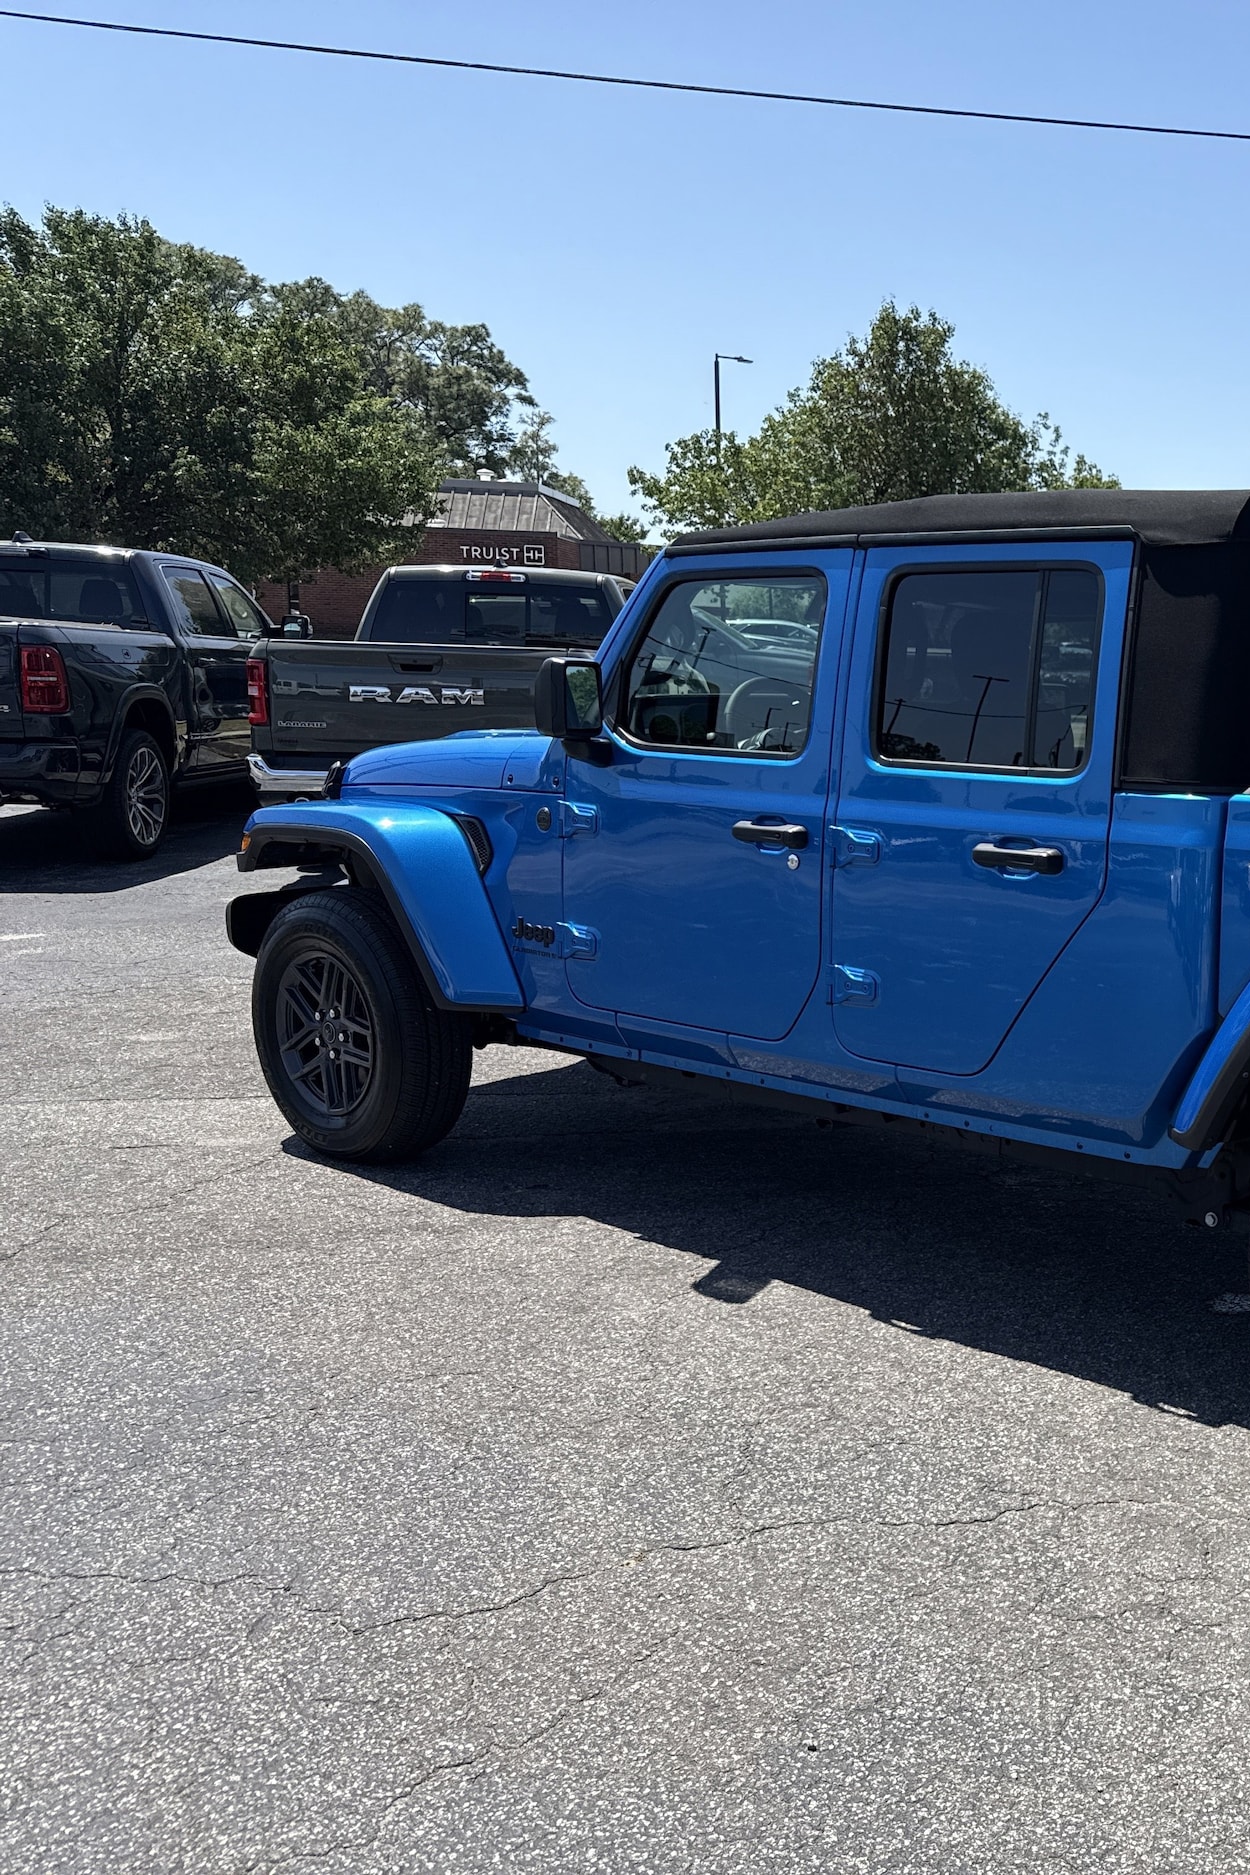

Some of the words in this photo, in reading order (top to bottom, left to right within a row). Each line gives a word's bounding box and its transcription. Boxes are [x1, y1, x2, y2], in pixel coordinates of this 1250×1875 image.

[460, 546, 520, 560] TRUIST
[349, 685, 485, 705] RAM
[511, 915, 555, 948] Jeep
